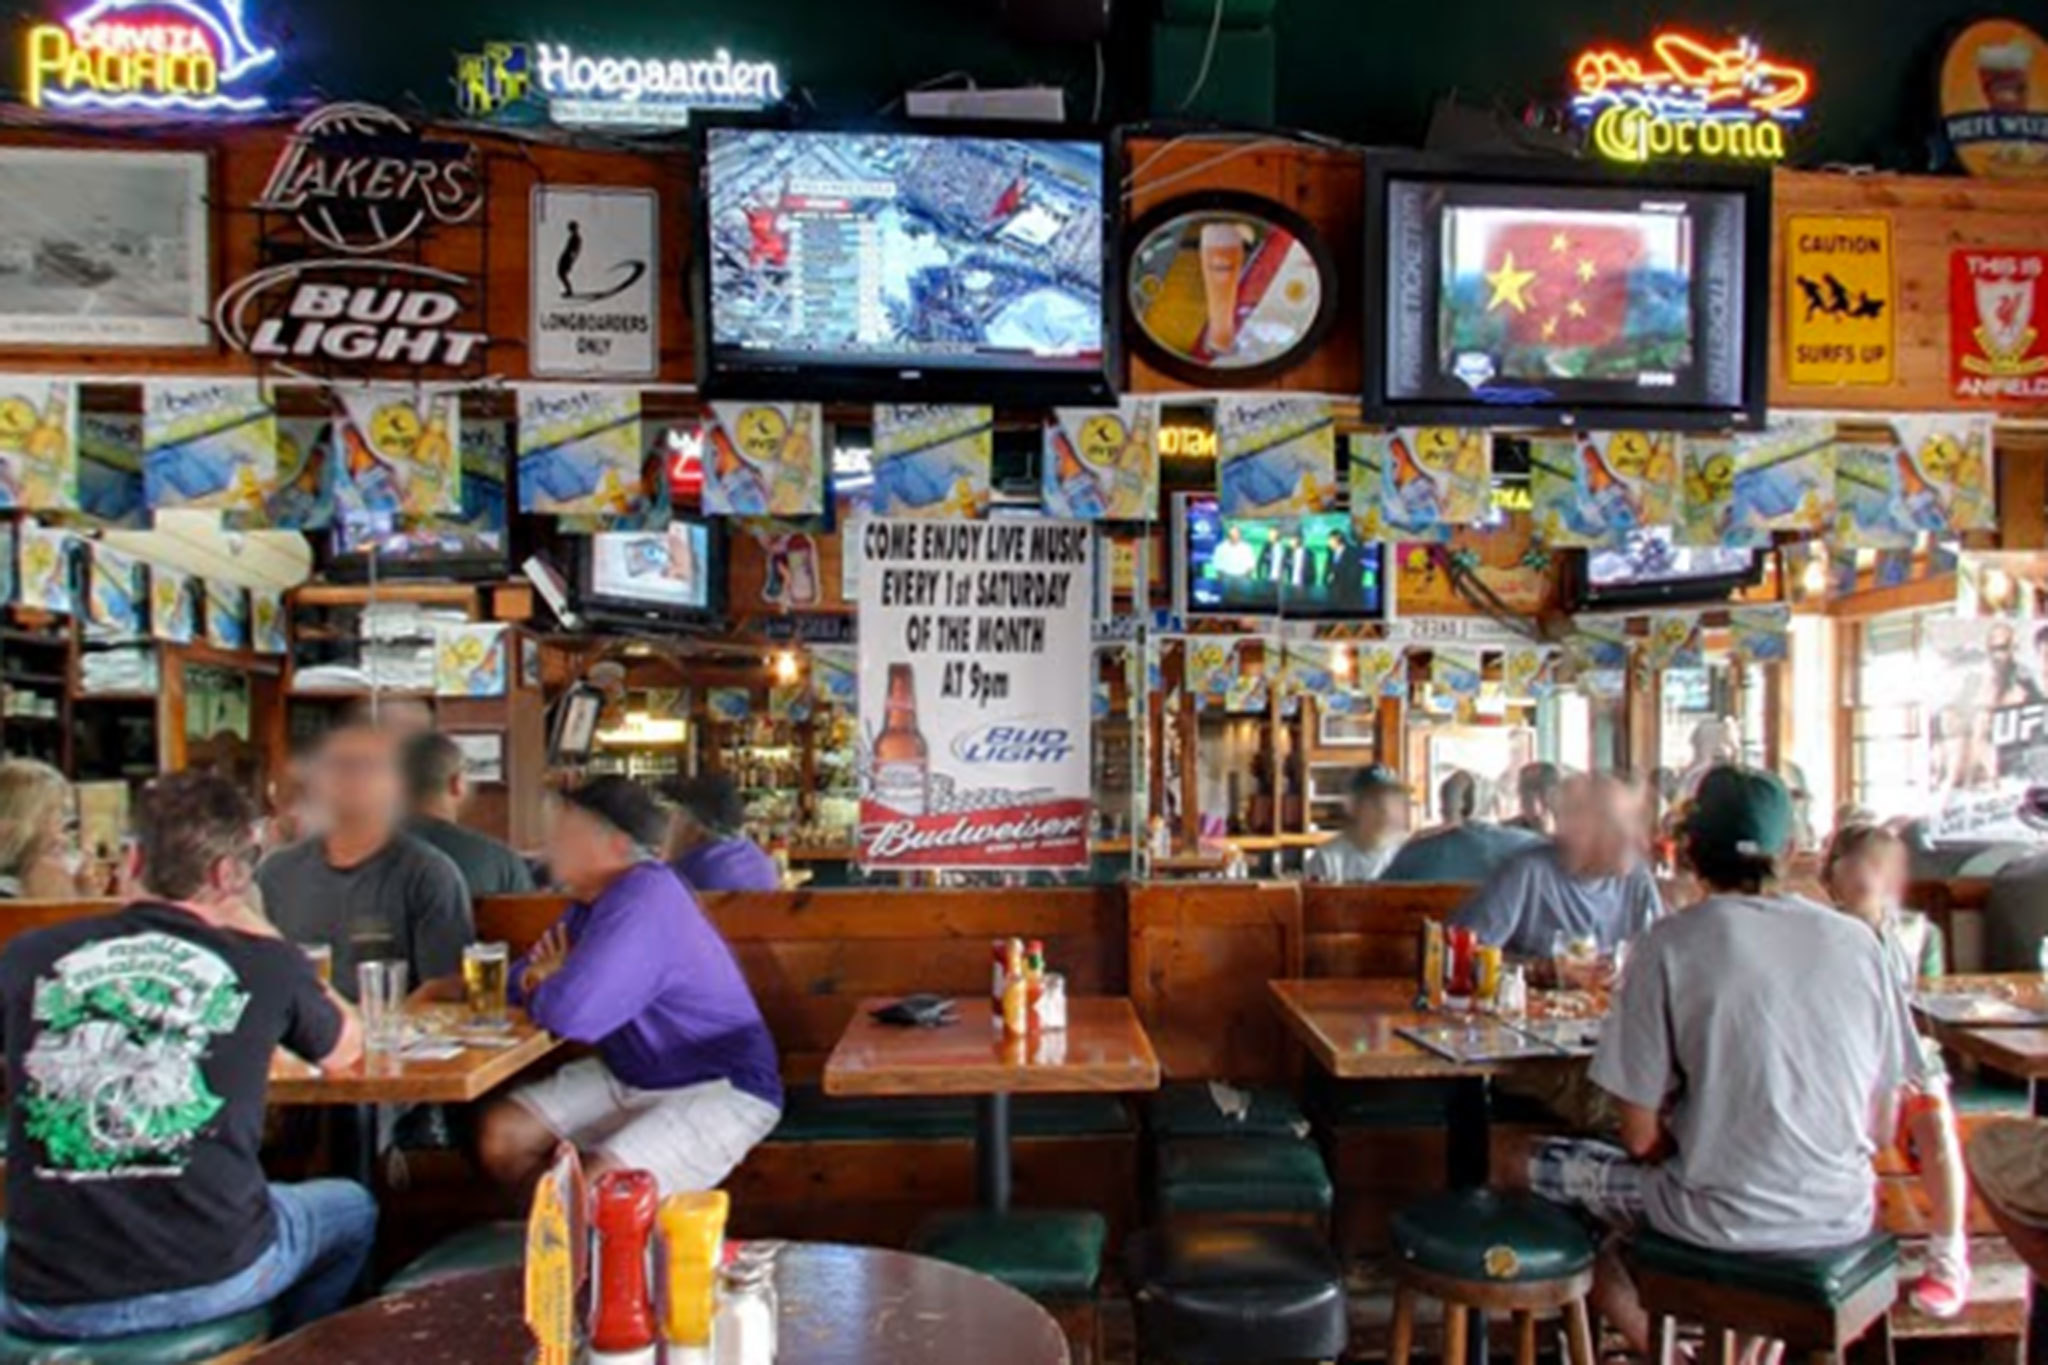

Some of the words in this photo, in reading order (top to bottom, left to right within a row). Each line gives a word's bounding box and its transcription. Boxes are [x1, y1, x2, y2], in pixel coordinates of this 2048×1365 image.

[535, 43, 783, 100] Hoegaarden
[1594, 104, 1784, 161] Corona
[250, 133, 483, 222] LAKERS
[1800, 234, 1881, 254] CAUTION
[1965, 255, 2017, 276] THIS
[2020, 256, 2043, 277] IS
[290, 284, 460, 326] BUD
[540, 311, 649, 333] LONGBOARDERS
[250, 320, 489, 365] LIGHT
[575, 337, 612, 355] ONLY
[1796, 344, 1855, 365] SURFS
[1861, 345, 1885, 364] UP
[864, 522, 916, 560] COME
[922, 523, 983, 561] ENJOY
[986, 525, 1025, 562] LIVE
[1030, 526, 1088, 563] MUSIC
[881, 569, 940, 606] EVERY
[945, 570, 971, 606] 1st
[976, 571, 1071, 608] SATURDAY
[906, 615, 932, 652] OF
[937, 616, 970, 652] THE
[975, 616, 1046, 653] MONTH
[941, 661, 965, 698] AT
[969, 661, 1009, 708] 9pm
[985, 726, 1070, 745] BUD
[1993, 704, 2048, 745] UF
[963, 745, 1075, 763] LIGHT
[858, 812, 1083, 858] Budweiser
